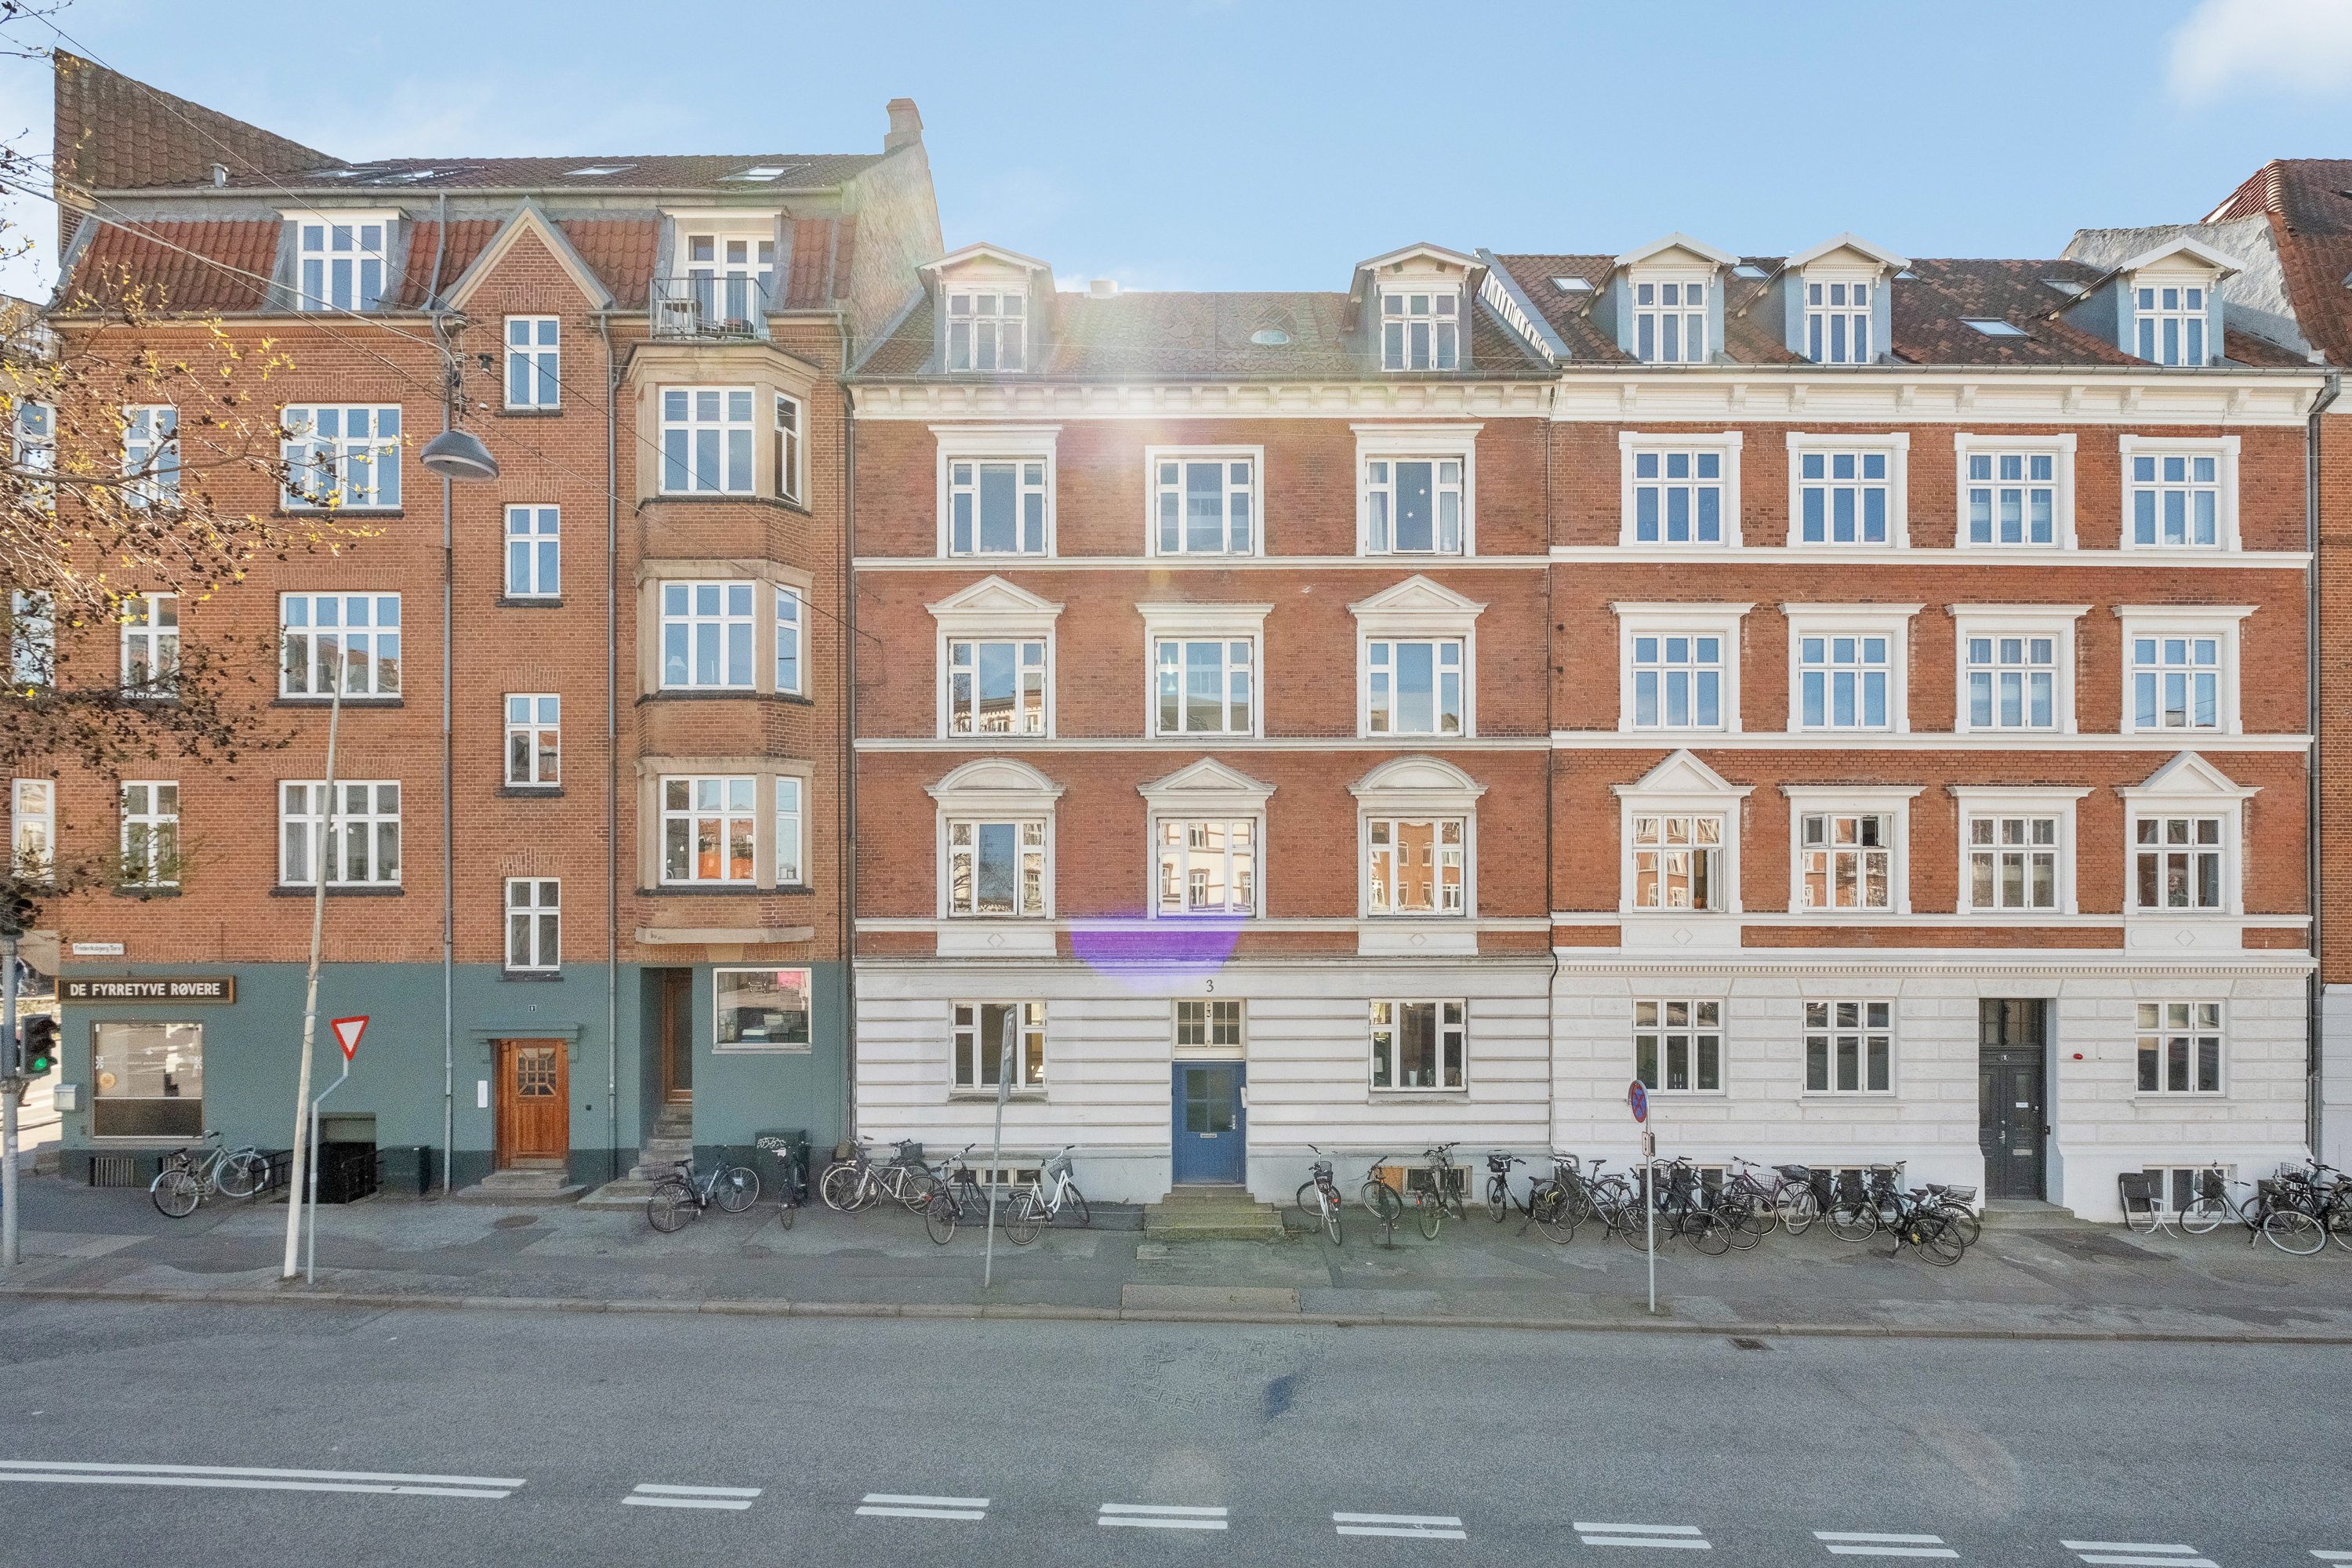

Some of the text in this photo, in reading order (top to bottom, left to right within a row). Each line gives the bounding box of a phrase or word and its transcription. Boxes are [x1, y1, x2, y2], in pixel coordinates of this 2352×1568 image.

[70, 982, 220, 996] DE FYRRETYVE RØVERE
[1206, 978, 1214, 993] 3
